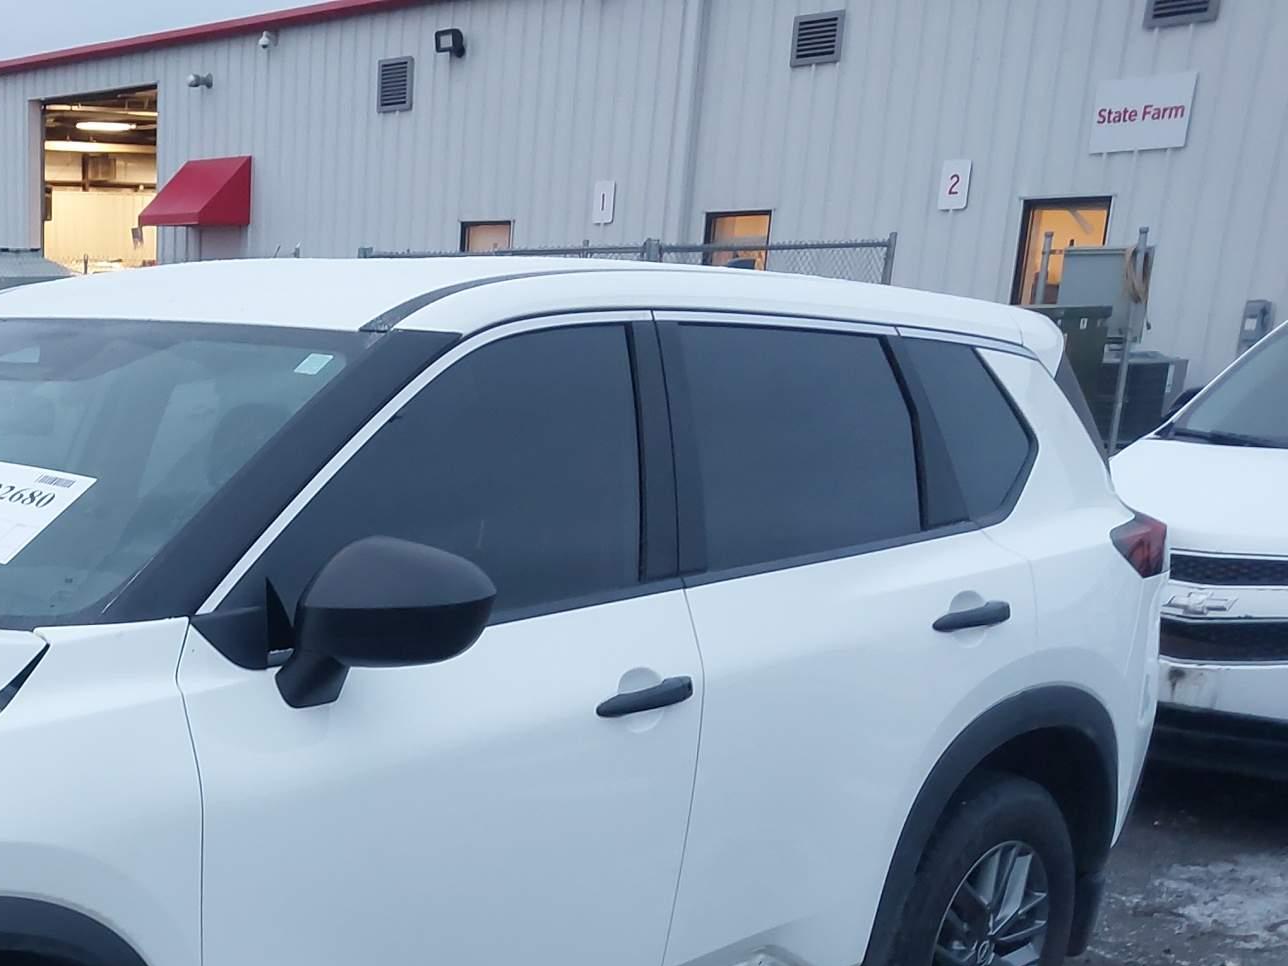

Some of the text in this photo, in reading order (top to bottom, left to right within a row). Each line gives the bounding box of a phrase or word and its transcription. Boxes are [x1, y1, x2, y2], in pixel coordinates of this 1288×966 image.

[1096, 104, 1185, 125] State Farm
[948, 173, 960, 195] 2
